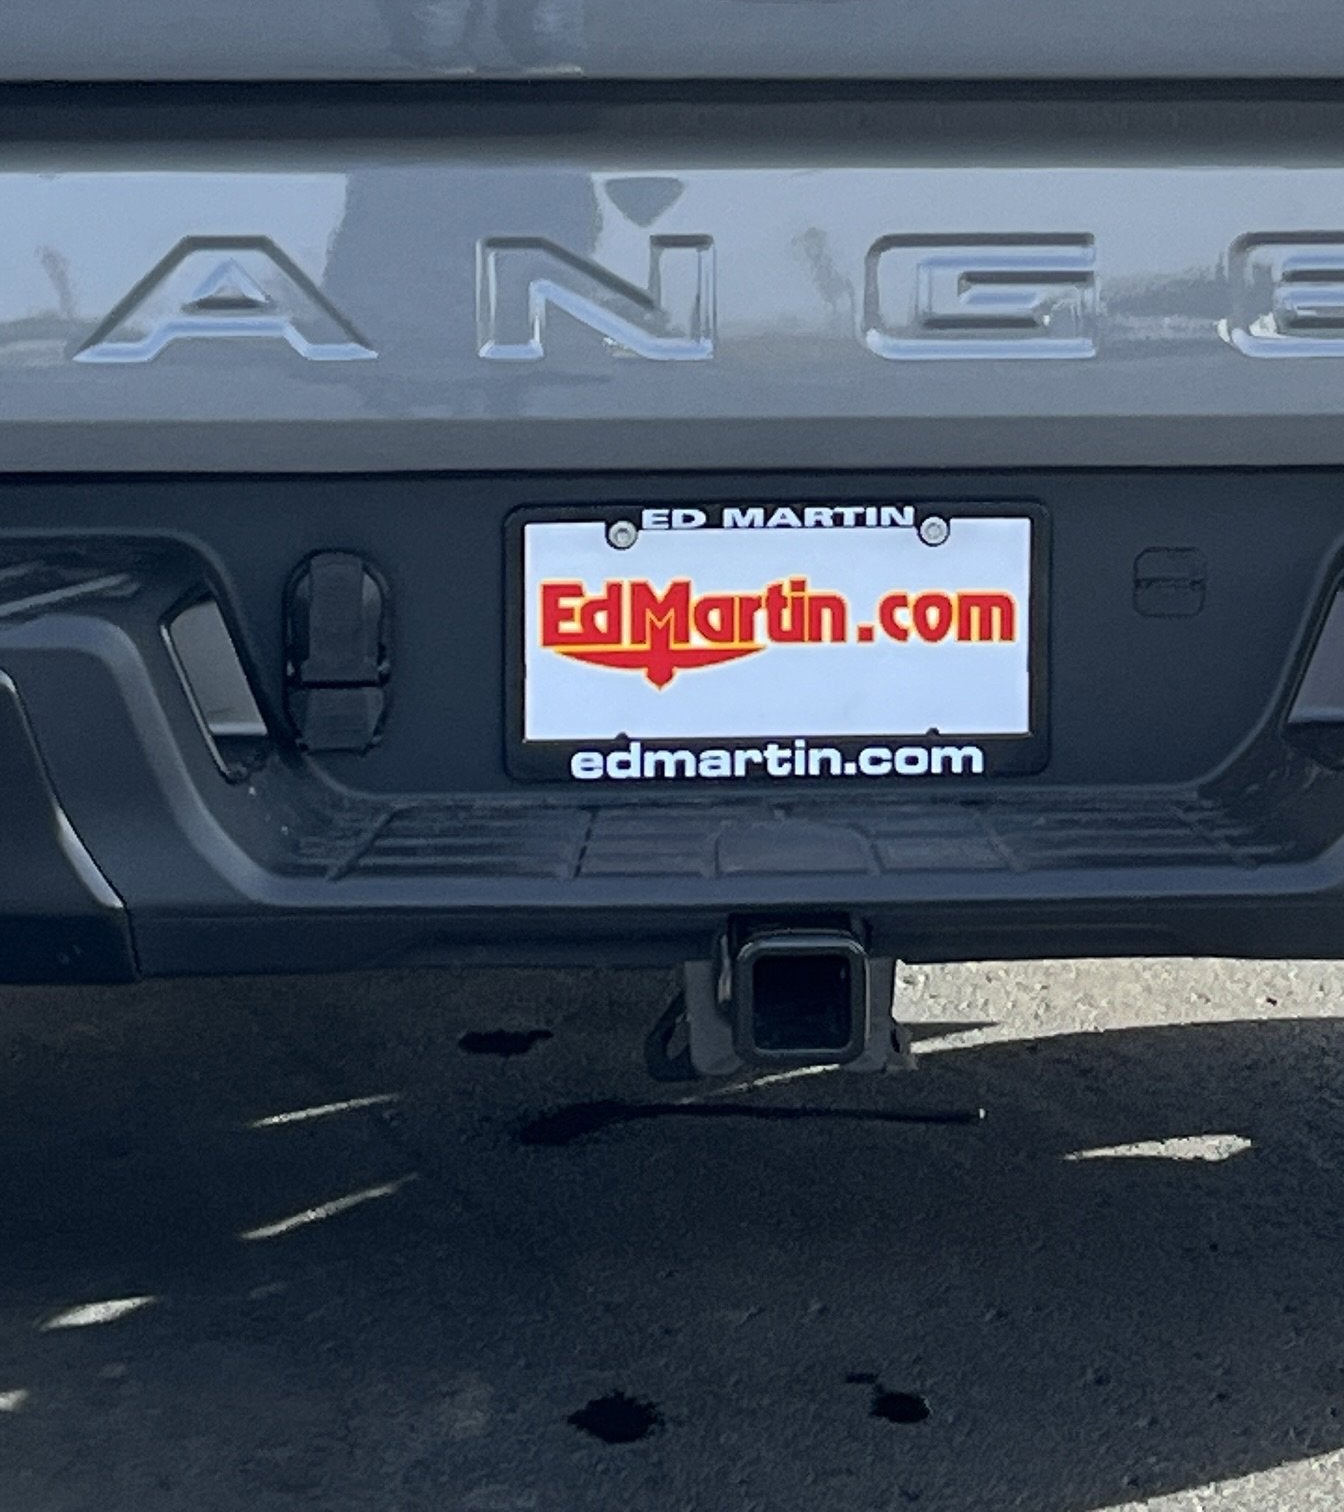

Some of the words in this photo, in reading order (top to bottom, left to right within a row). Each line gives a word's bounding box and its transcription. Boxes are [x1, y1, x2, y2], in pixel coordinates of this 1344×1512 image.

[641, 508, 707, 530] ED
[723, 506, 915, 528] MARTIN
[540, 576, 1015, 647] EdMartin.com
[570, 739, 984, 780] edmartin.com
